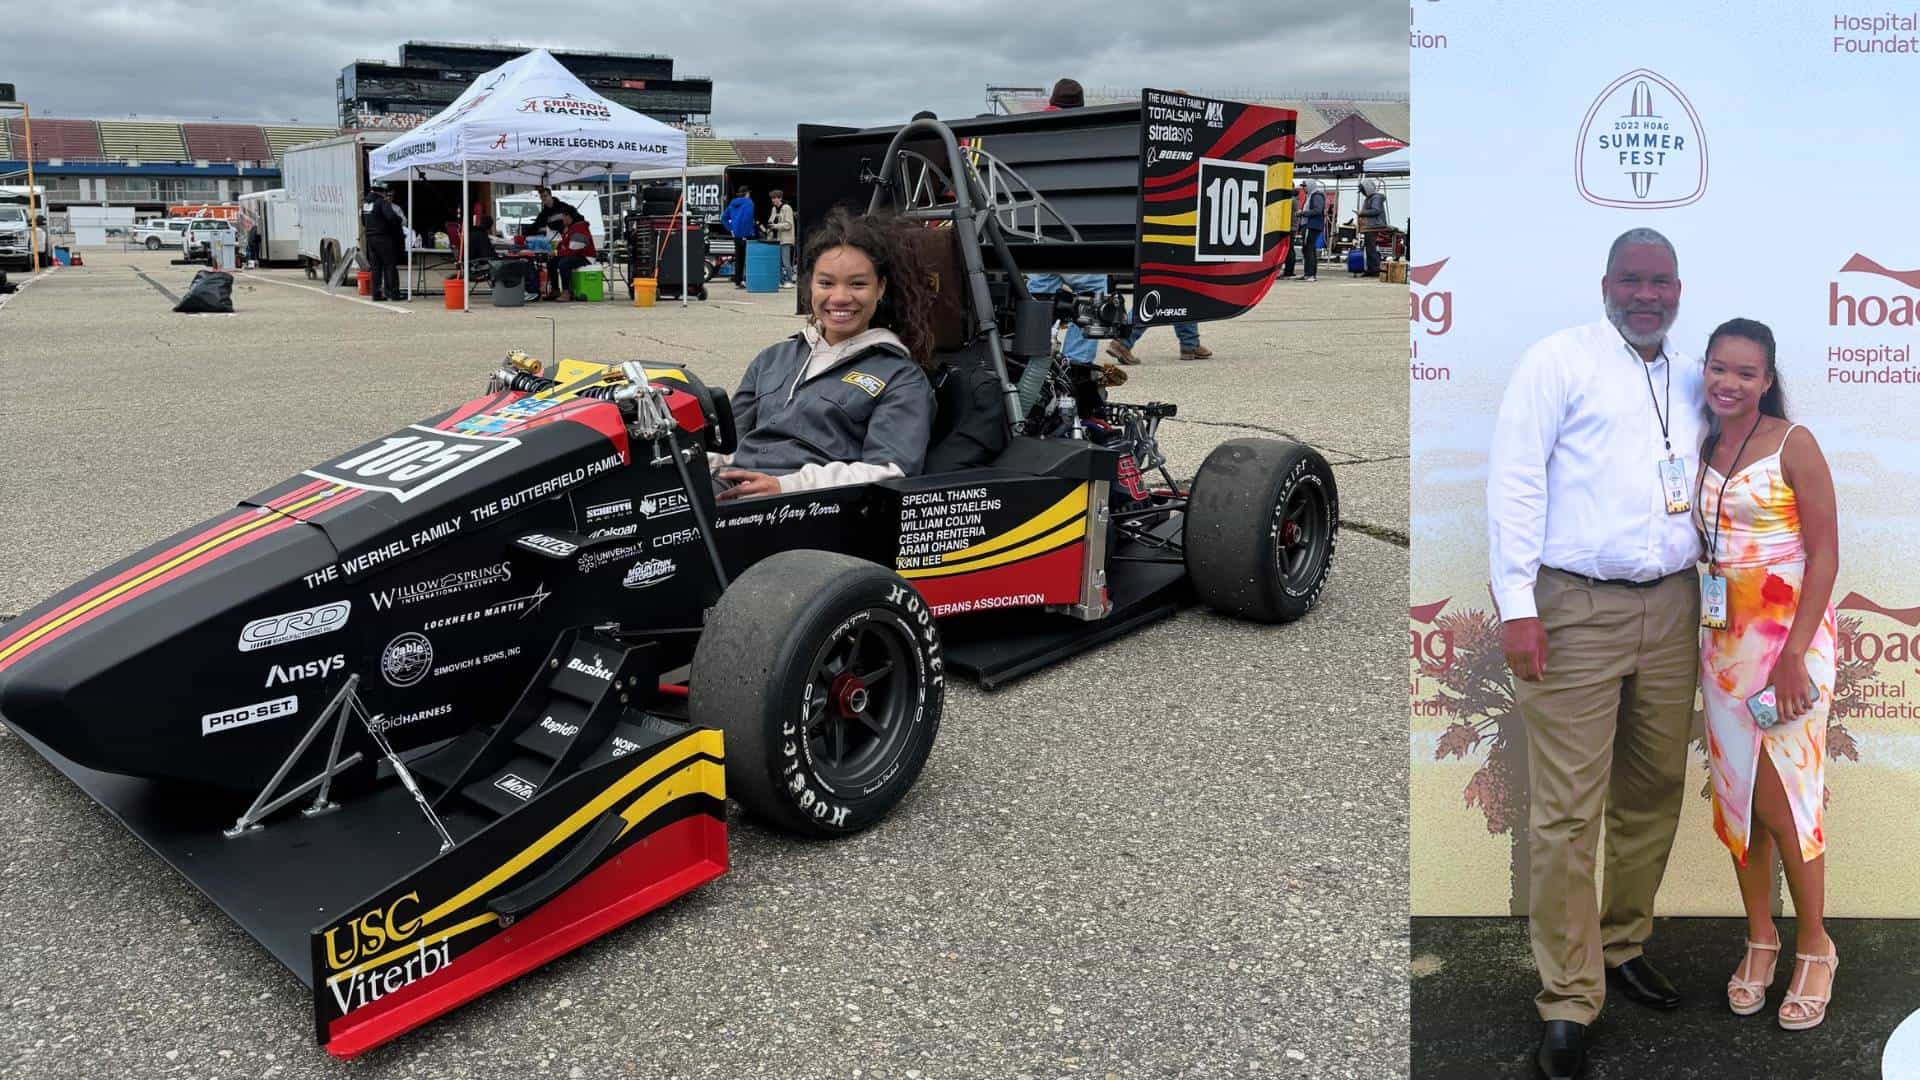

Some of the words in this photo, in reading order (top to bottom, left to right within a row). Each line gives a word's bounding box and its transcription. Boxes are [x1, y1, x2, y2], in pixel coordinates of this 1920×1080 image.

[1834, 12, 1917, 36] Hospital
[543, 100, 608, 111] CRIMSON
[1148, 92, 1160, 104] THE
[544, 107, 611, 117] RACING
[1148, 106, 1194, 123] TOTALSIM
[1148, 123, 1193, 145] stratasys
[1614, 121, 1639, 130] 2022
[1643, 121, 1669, 131] HOAG
[528, 137, 565, 147] WHERE
[567, 138, 614, 149] LEGENDS
[617, 141, 637, 151] ARE
[640, 144, 668, 154] MADE
[1599, 133, 1684, 151] SUMMER
[1159, 150, 1193, 161] BOEING
[1619, 151, 1665, 166] FEST
[1206, 177, 1259, 246] 105
[1828, 344, 1910, 366] Hospital
[1828, 365, 1920, 384] Foundati
[334, 436, 484, 481] 105
[902, 492, 944, 506] SPECIAL
[947, 487, 987, 501] THANKS
[715, 518, 725, 529] in
[728, 512, 764, 526] memory
[766, 507, 777, 525] of
[780, 504, 806, 524] Gary
[808, 502, 840, 516] Norris
[901, 508, 918, 521] DR.
[921, 504, 948, 518] YANN
[950, 499, 1001, 514] STAELENS
[304, 565, 339, 590] THE
[342, 540, 410, 576] WERHEL
[411, 516, 462, 548] FAMILY
[470, 501, 499, 522] THE
[501, 468, 585, 511] BUTTERFIELD
[587, 451, 625, 476] FAMILY
[901, 518, 943, 532] WILLIAM
[945, 513, 981, 527] COLVIN
[653, 527, 700, 547] CORSA
[899, 531, 934, 545] CESAR
[936, 526, 986, 540] RENTERIA
[899, 543, 929, 556] ARAM
[931, 538, 969, 552] OHANIS
[922, 554, 942, 566] LEE
[369, 578, 439, 611] WILLOW
[457, 561, 512, 585] SPRINGS
[401, 586, 462, 604] INTERNATIONAL
[973, 593, 1045, 611] ASSOCIATION
[243, 604, 348, 642] CRD
[424, 611, 480, 631] LOCKHEED
[484, 601, 525, 617] MARTIN
[434, 658, 474, 676] SIMOVICH
[507, 646, 521, 657] INC
[265, 654, 345, 688] Ansys
[325, 891, 423, 970] USC
[327, 936, 452, 1016] Viterbi
